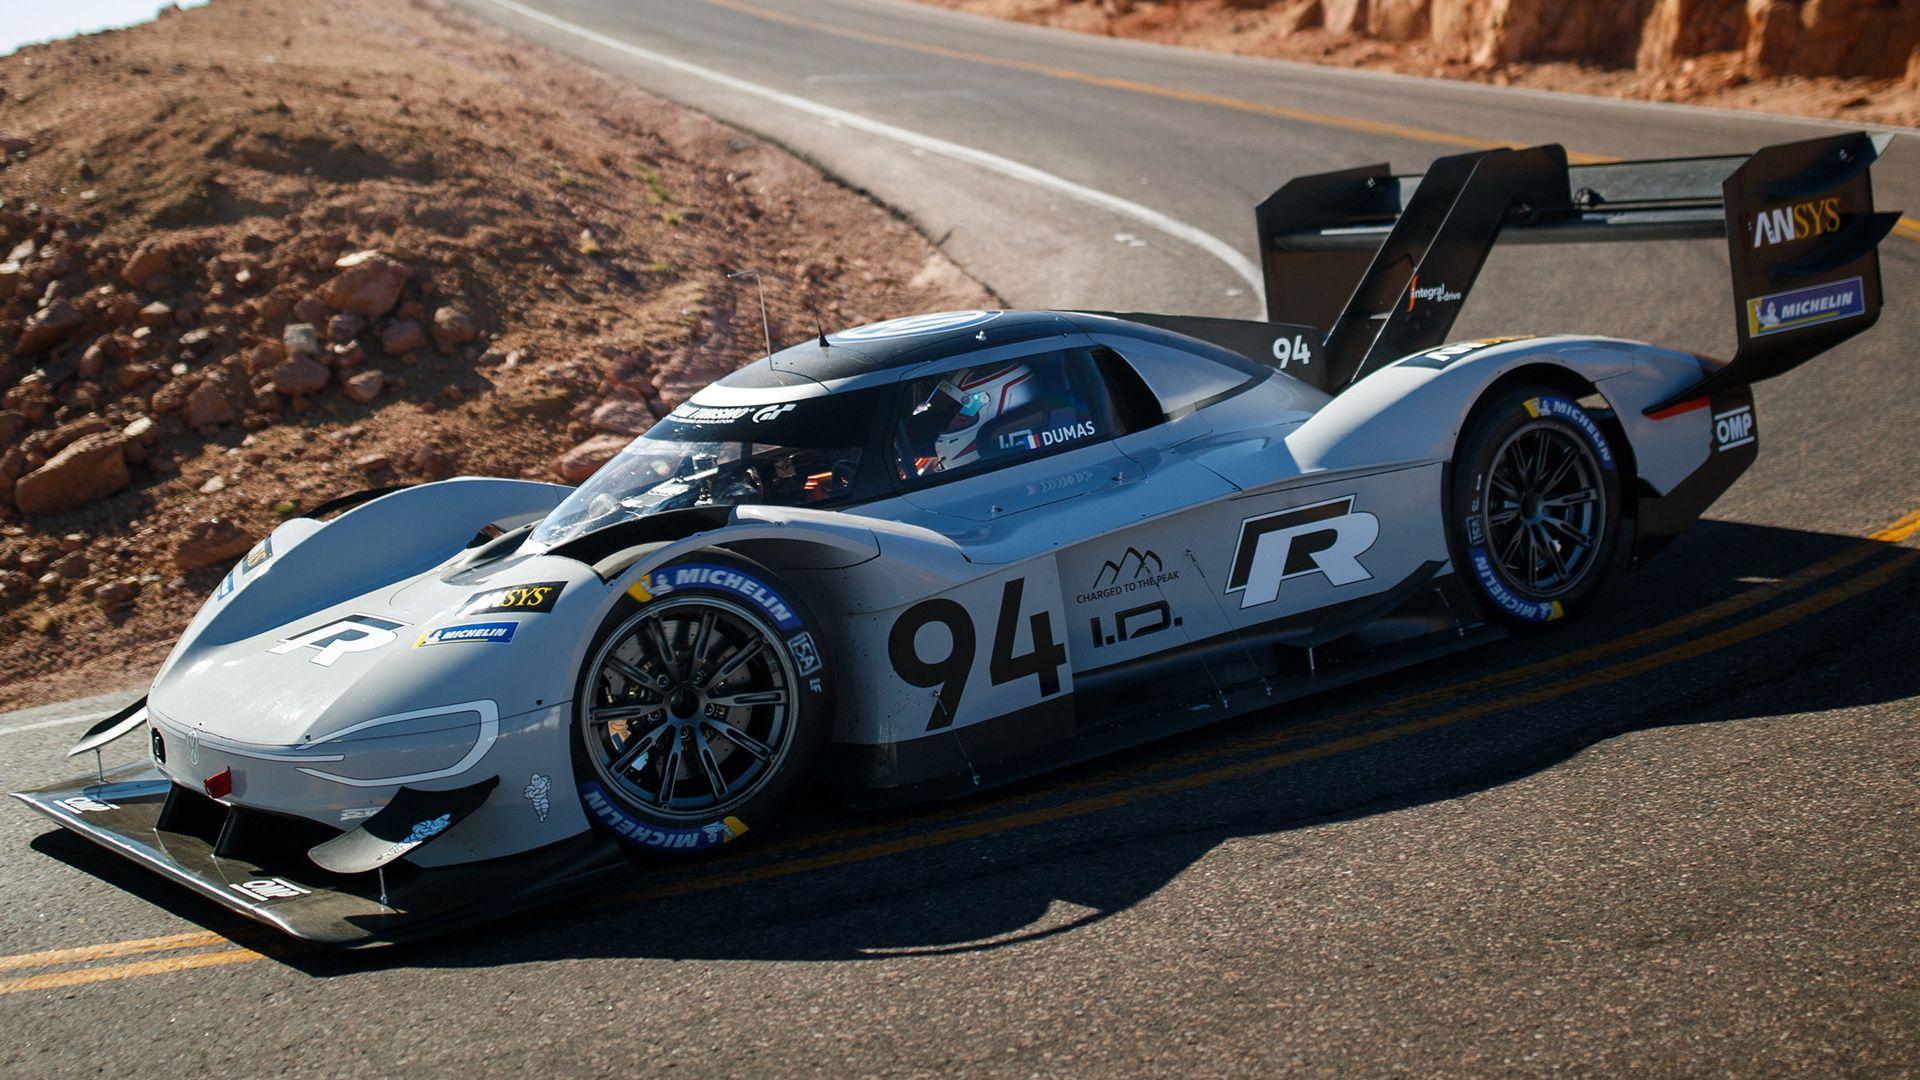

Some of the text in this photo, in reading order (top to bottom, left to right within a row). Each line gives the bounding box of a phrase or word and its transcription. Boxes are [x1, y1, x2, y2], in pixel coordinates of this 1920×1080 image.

[1754, 197, 1841, 248] ANSYS
[1781, 291, 1854, 319] MICHELIN
[1273, 335, 1311, 369] 94
[1042, 420, 1096, 446] DUMAS
[1553, 401, 1612, 461] MICHELIN
[1716, 412, 1752, 443] OMP
[1226, 495, 1380, 610] R
[676, 568, 793, 622] MICHELIN
[1076, 570, 1181, 604] CHARGED TO THE PEAK
[1475, 556, 1537, 618] MICHELIN
[442, 628, 508, 641] MICHELIN
[1090, 600, 1183, 648] I.D.
[888, 577, 1067, 732] 94
[584, 791, 700, 848] MICHELIN
